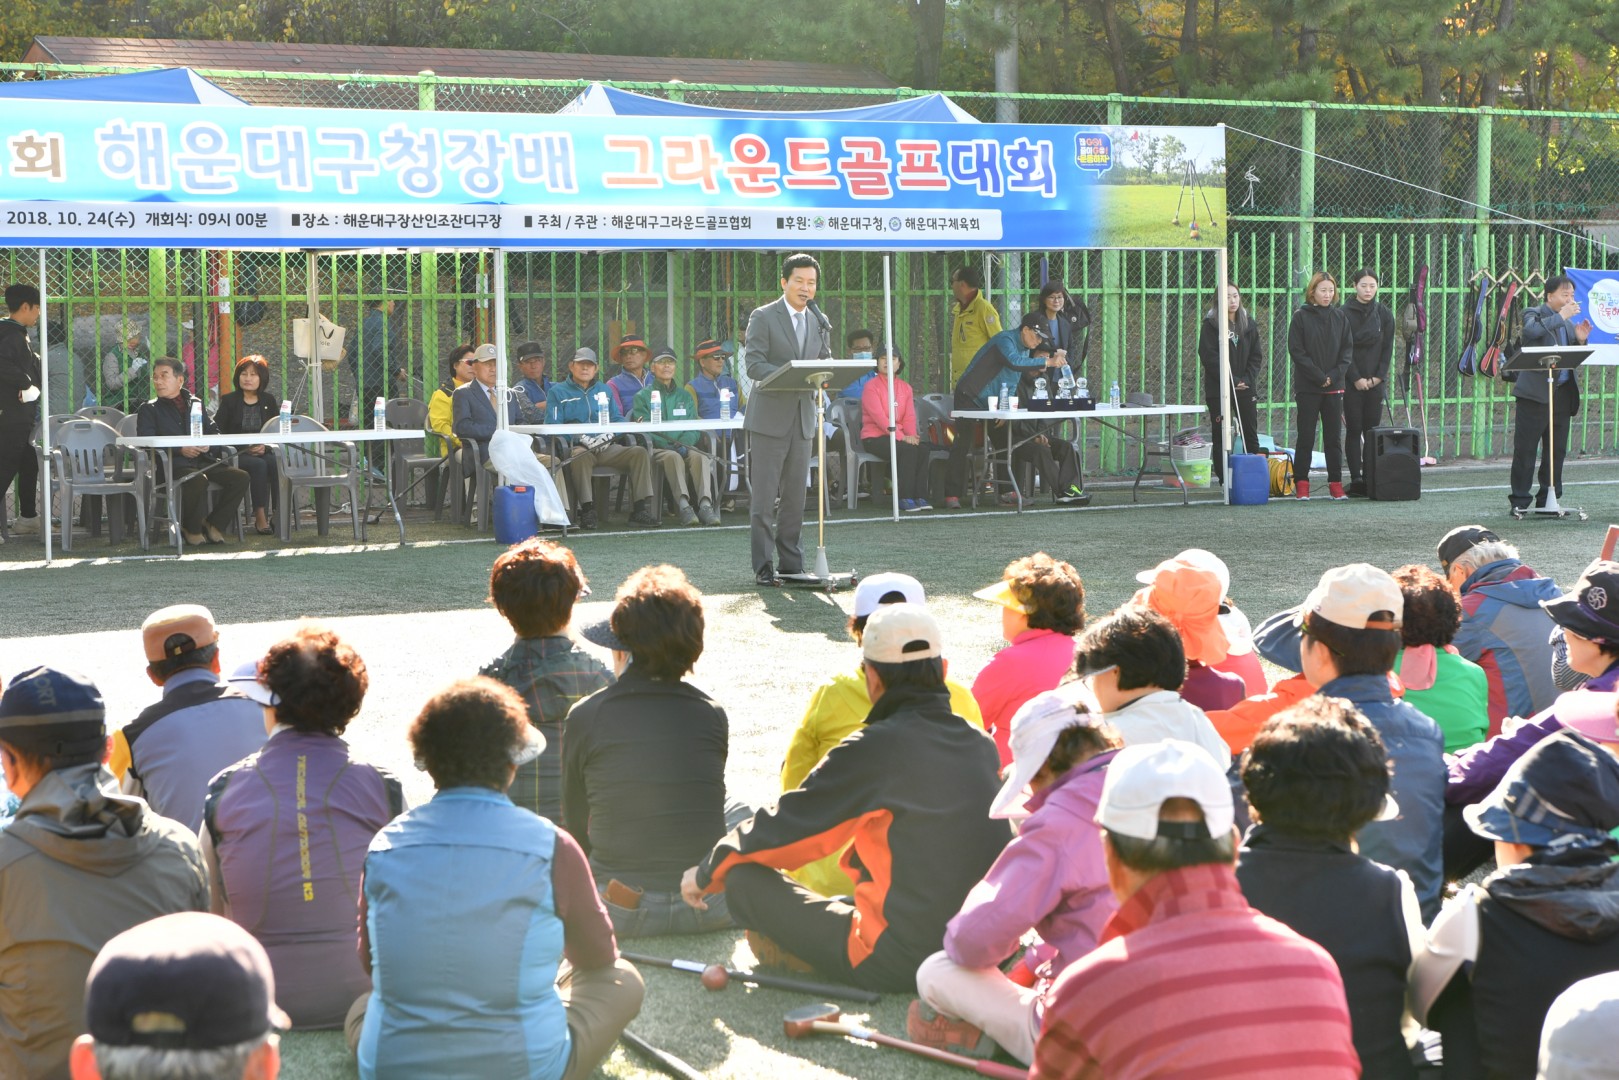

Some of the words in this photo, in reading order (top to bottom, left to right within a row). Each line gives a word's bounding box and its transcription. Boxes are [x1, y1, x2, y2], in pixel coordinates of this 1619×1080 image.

[11, 134, 62, 178] 회
[98, 122, 576, 195] 해운대구청장배
[604, 135, 1058, 198] 그라운드골프대회
[7, 211, 52, 226] 2018.
[58, 211, 82, 226] 10.
[87, 211, 135, 229] 24(수)
[145, 211, 193, 228] 개회식:
[198, 212, 231, 227] 09시
[235, 212, 268, 228] 00분
[302, 213, 330, 229] 장소
[343, 213, 502, 229] 해운대구장산인조잔디구장
[537, 214, 561, 228] 주최
[574, 214, 598, 229] 주관
[611, 214, 751, 230] 해운대구그라운드골프협회
[905, 217, 980, 231] 해운대구체육회
[302, 882, 315, 902] K2
